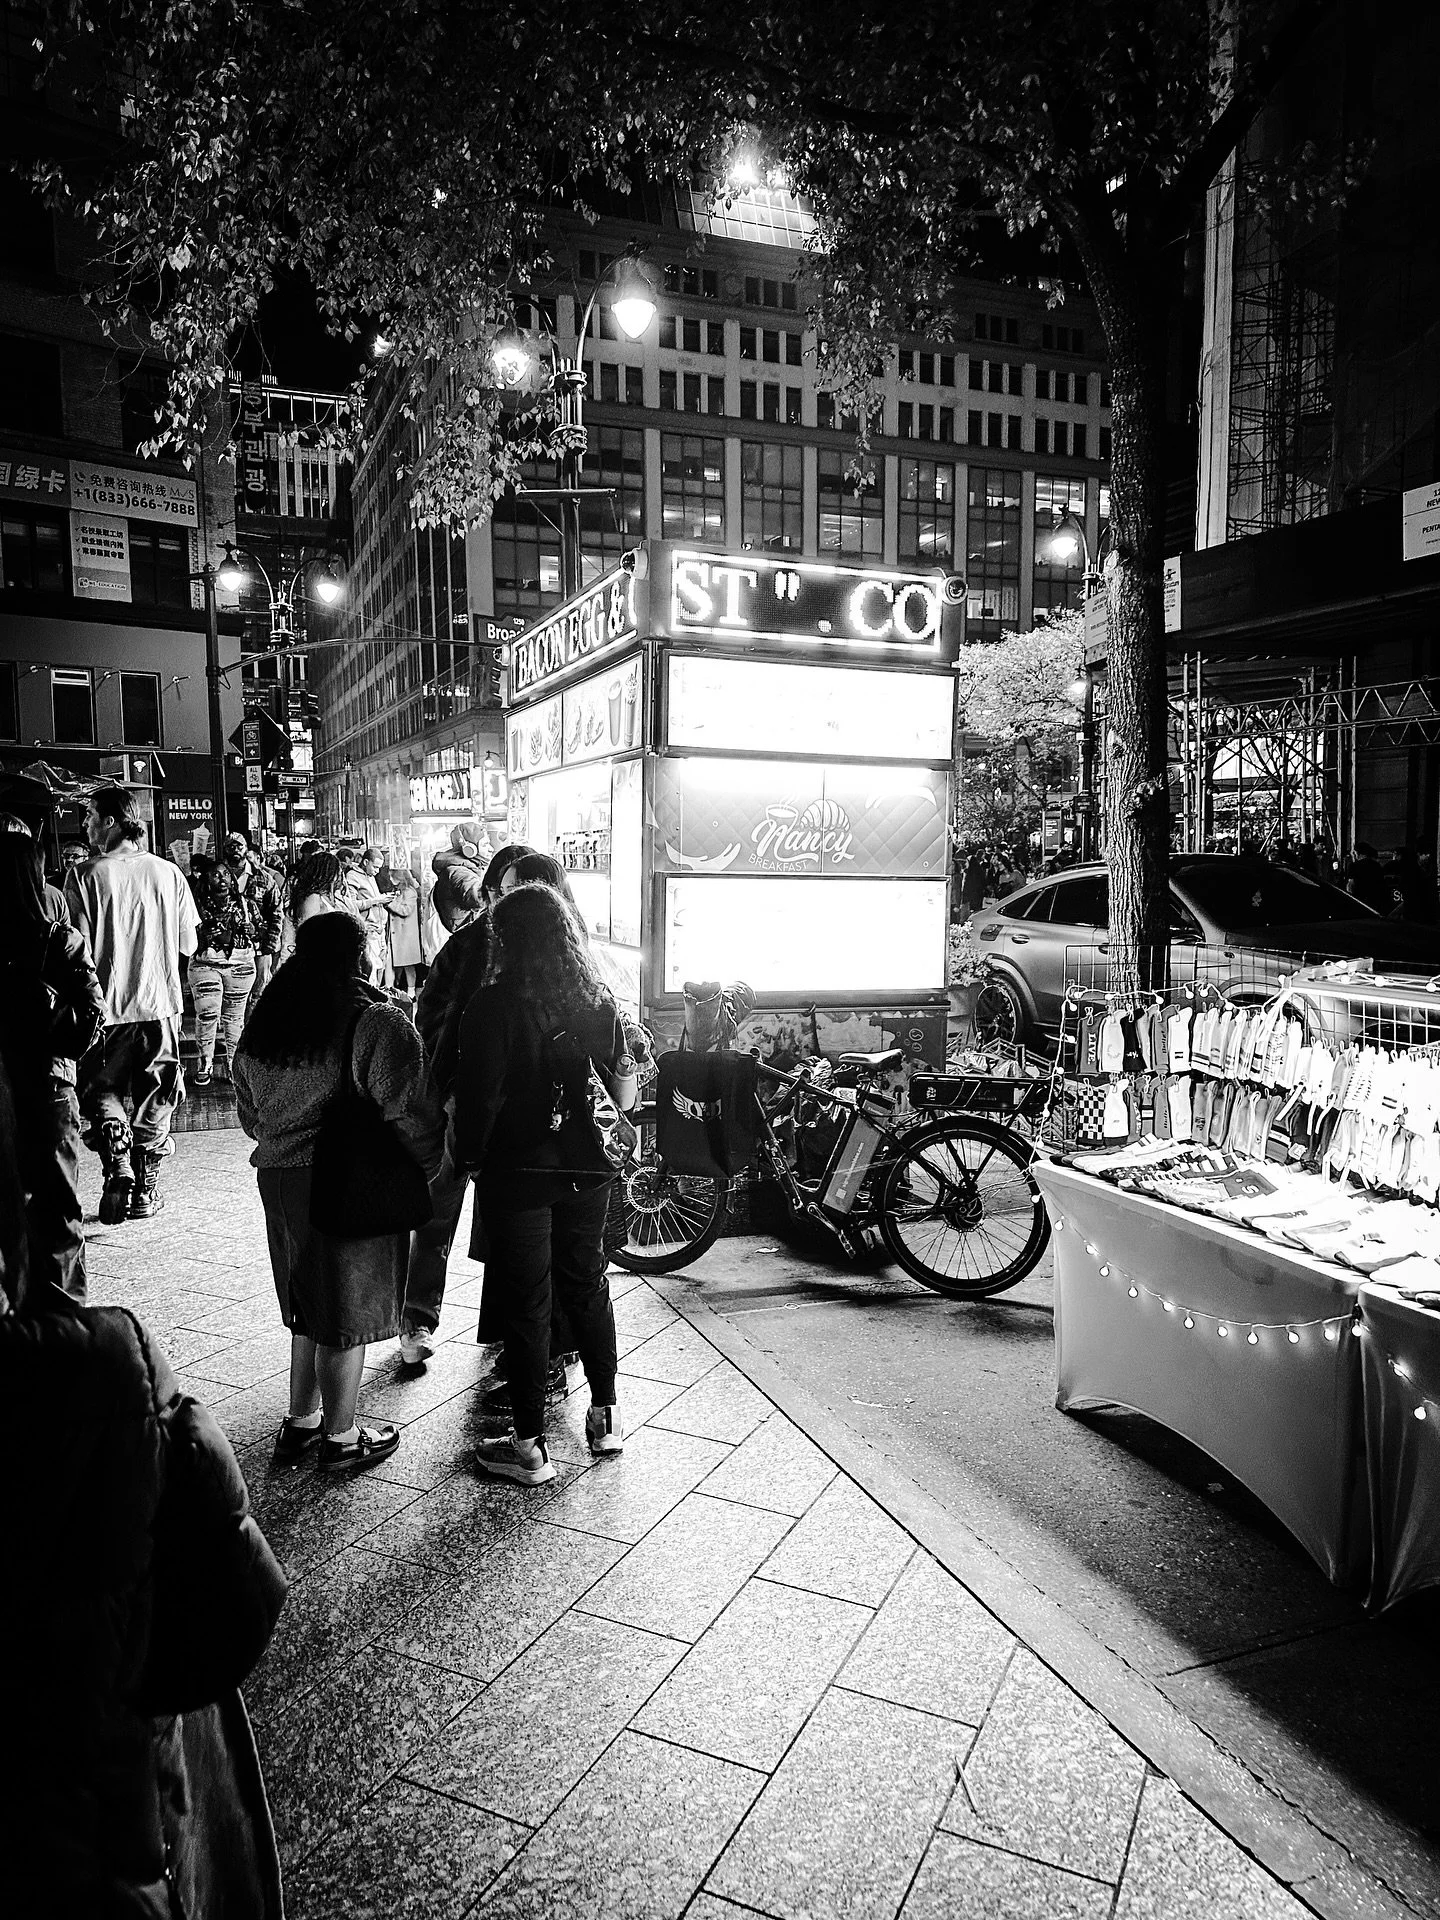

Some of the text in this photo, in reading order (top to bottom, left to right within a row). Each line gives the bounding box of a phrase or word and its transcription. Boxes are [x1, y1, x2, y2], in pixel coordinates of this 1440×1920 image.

[90, 473, 167, 497] 免费咨询热线
[74, 487, 196, 516] +1(833)666-7888
[517, 616, 567, 689] BACON
[568, 591, 606, 662] EGG
[607, 580, 625, 639] &
[168, 798, 212, 811] HELLO
[168, 812, 213, 821] NEW YORK
[751, 819, 855, 864] Nancy
[748, 853, 807, 872] BREAKFAST
